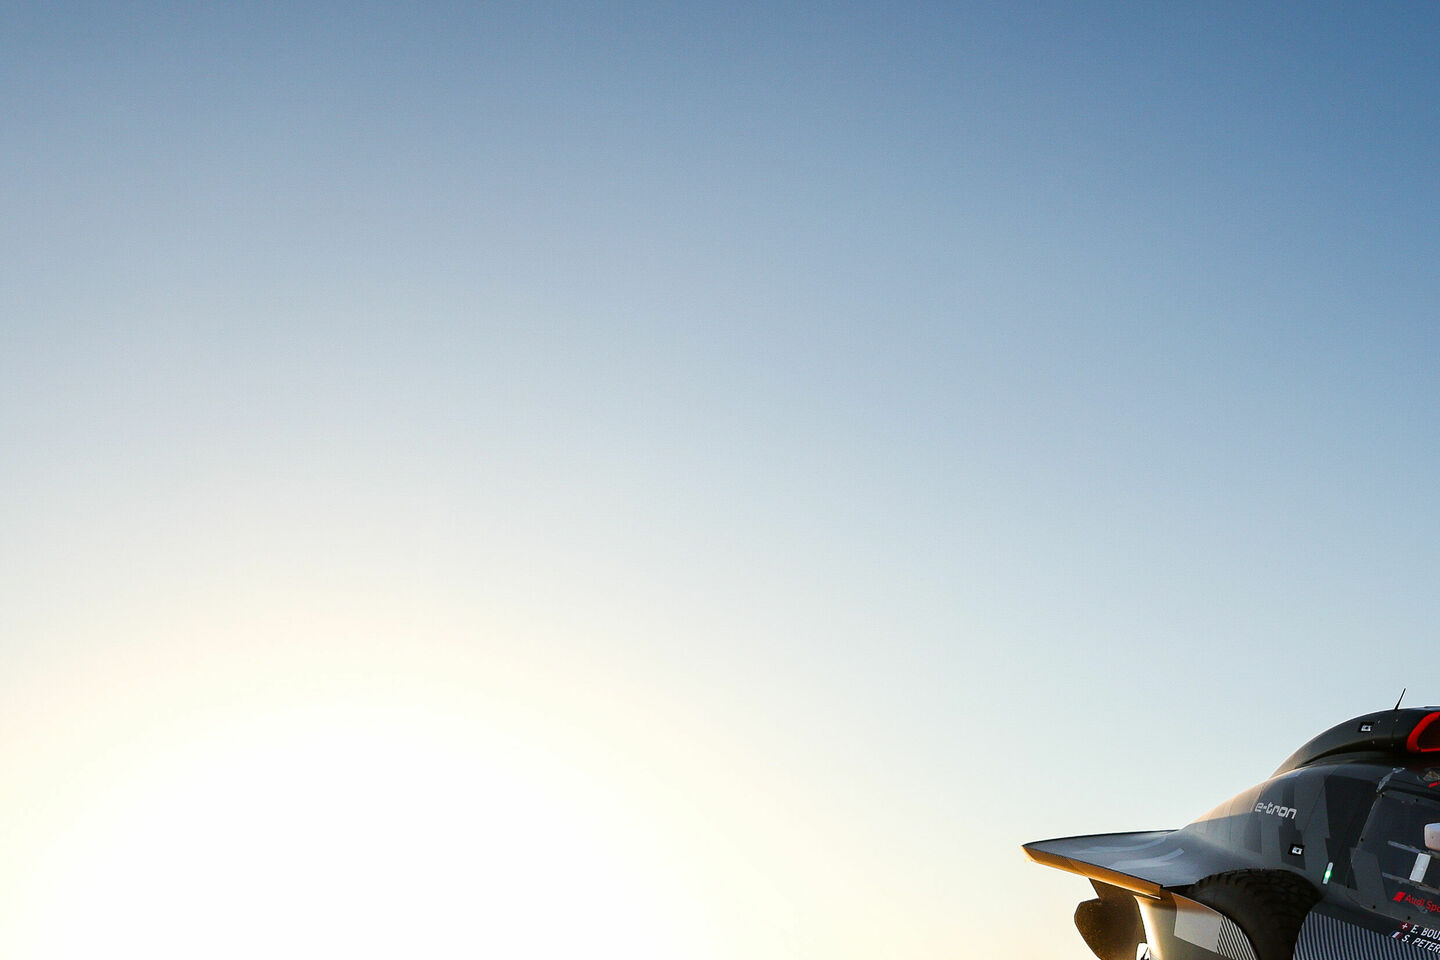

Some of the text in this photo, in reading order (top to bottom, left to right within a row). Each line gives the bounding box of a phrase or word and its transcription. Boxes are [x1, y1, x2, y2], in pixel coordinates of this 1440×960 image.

[1254, 802, 1297, 819] e-tron
[1404, 894, 1425, 906] Audi
[1410, 924, 1420, 934] E.
[1401, 934, 1411, 943] S.
